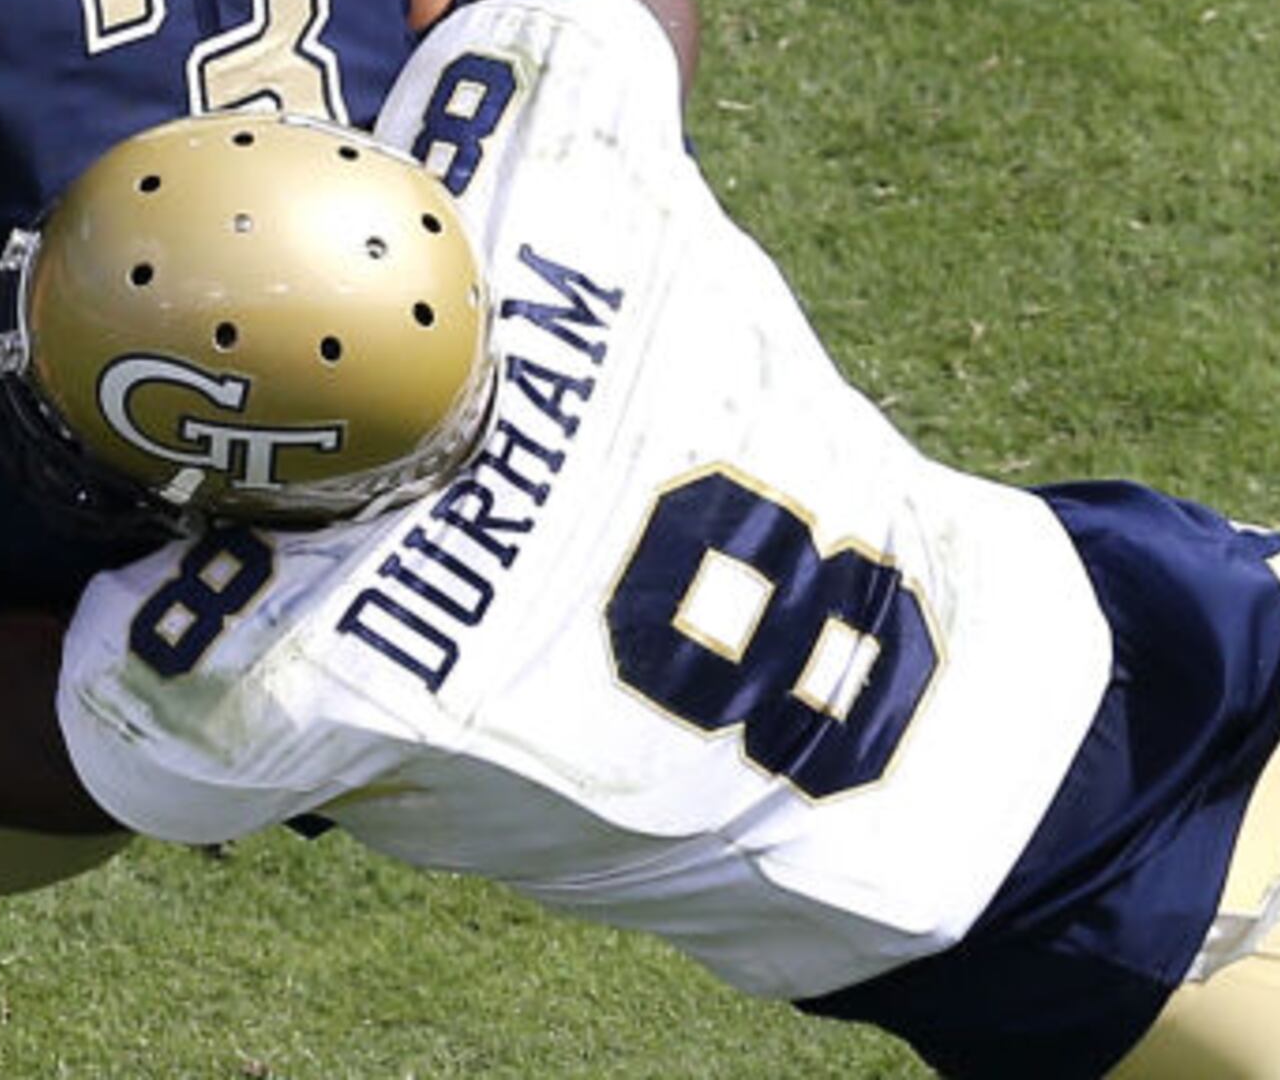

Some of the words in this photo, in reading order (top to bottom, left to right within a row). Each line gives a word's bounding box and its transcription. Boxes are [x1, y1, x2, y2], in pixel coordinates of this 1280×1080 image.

[413, 52, 519, 196] 8
[97, 353, 346, 491] GT
[338, 245, 622, 692] DURHAM
[129, 526, 275, 678] 8
[606, 462, 948, 806] 8
